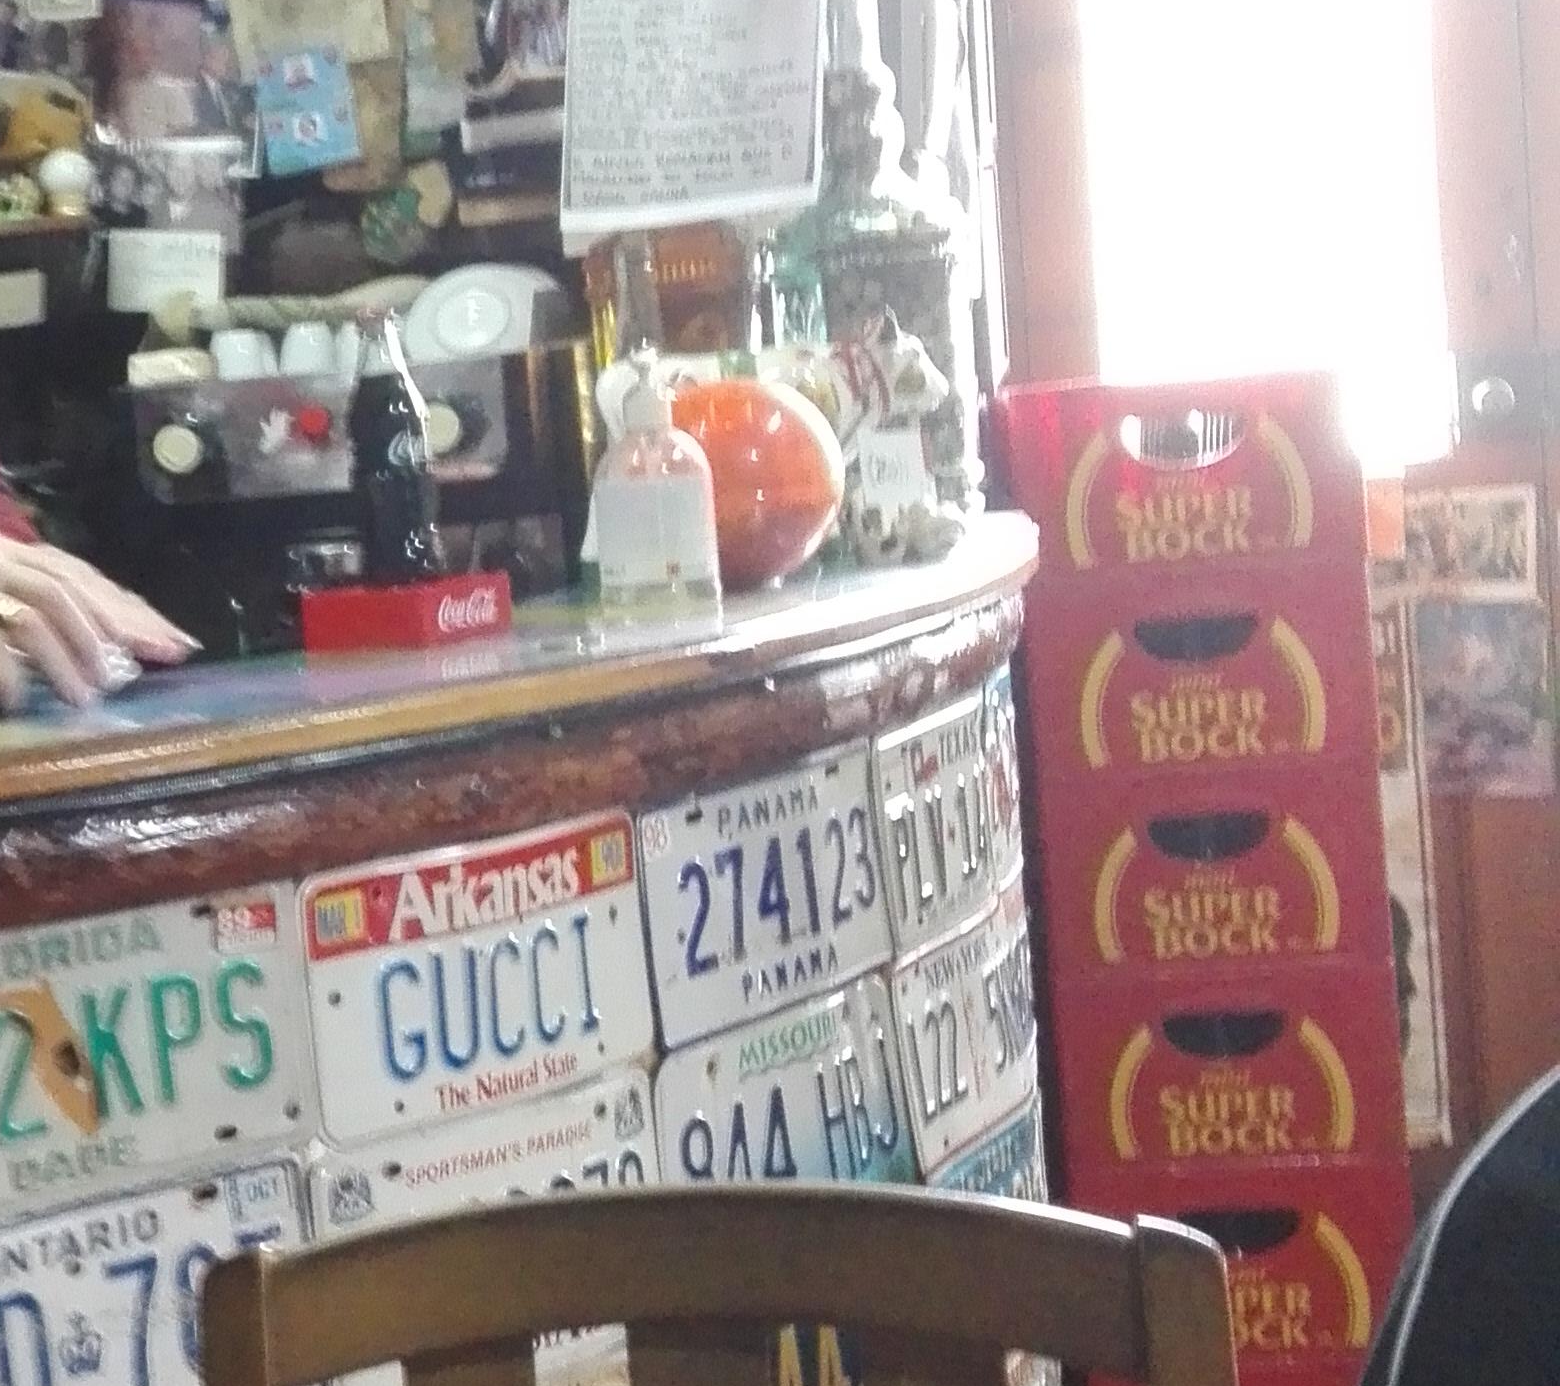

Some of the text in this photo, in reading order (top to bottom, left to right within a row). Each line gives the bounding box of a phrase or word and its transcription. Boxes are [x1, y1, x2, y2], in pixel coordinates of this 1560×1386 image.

[1115, 486, 1252, 525] SUPER
[1125, 518, 1251, 564] BOCK
[1131, 686, 1266, 728] SUPER
[1140, 722, 1265, 765] BOCK
[718, 783, 818, 839] PANAMA
[387, 846, 581, 942] Arkansas
[678, 807, 876, 979] 274123
[1144, 885, 1279, 925] SUPER
[1154, 919, 1278, 961] BOCK
[378, 912, 600, 1083] GUCCI
[741, 942, 838, 1001] PANAMA
[80, 956, 275, 1119] KPS
[739, 1014, 837, 1068] MISSOURI
[434, 1051, 578, 1111] The Natural State
[1158, 1082, 1295, 1124] SUPER
[405, 1137, 523, 1187] SPORTSMAN'S
[1167, 1115, 1292, 1157] BOCK
[7, 1134, 136, 1191] DADE
